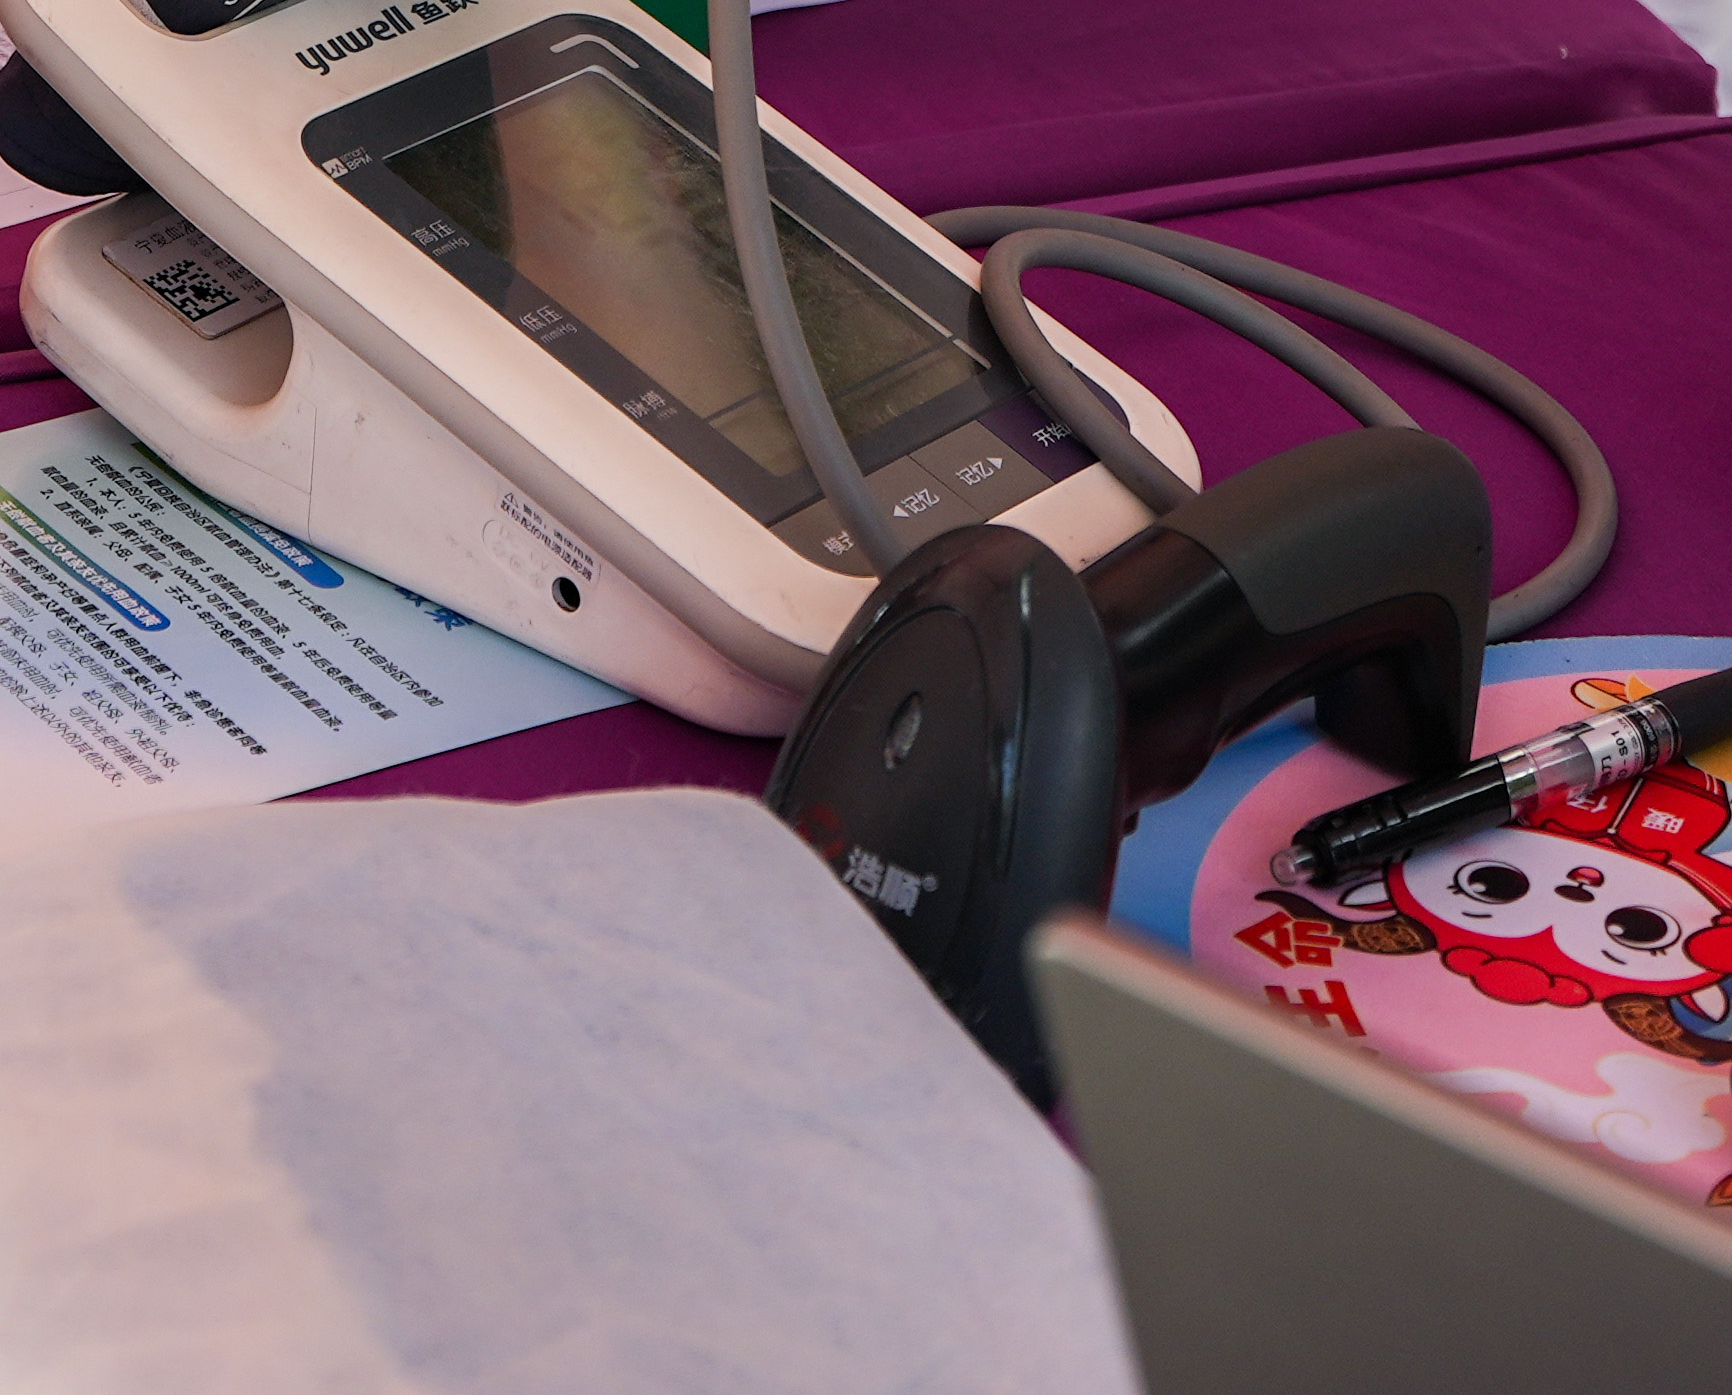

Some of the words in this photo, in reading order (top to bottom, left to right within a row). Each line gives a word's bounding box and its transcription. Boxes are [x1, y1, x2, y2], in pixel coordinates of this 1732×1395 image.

[294, 6, 415, 76] yuwell
[345, 154, 373, 171] BPM
[410, 219, 456, 247] 高压
[432, 236, 471, 258] mmHg
[519, 305, 564, 332] 低压
[539, 322, 579, 344] mmHg
[622, 390, 666, 419] 脉搏
[956, 459, 995, 486] 记忆
[903, 487, 941, 514] 记忆
[843, 848, 922, 918] 浩顺
